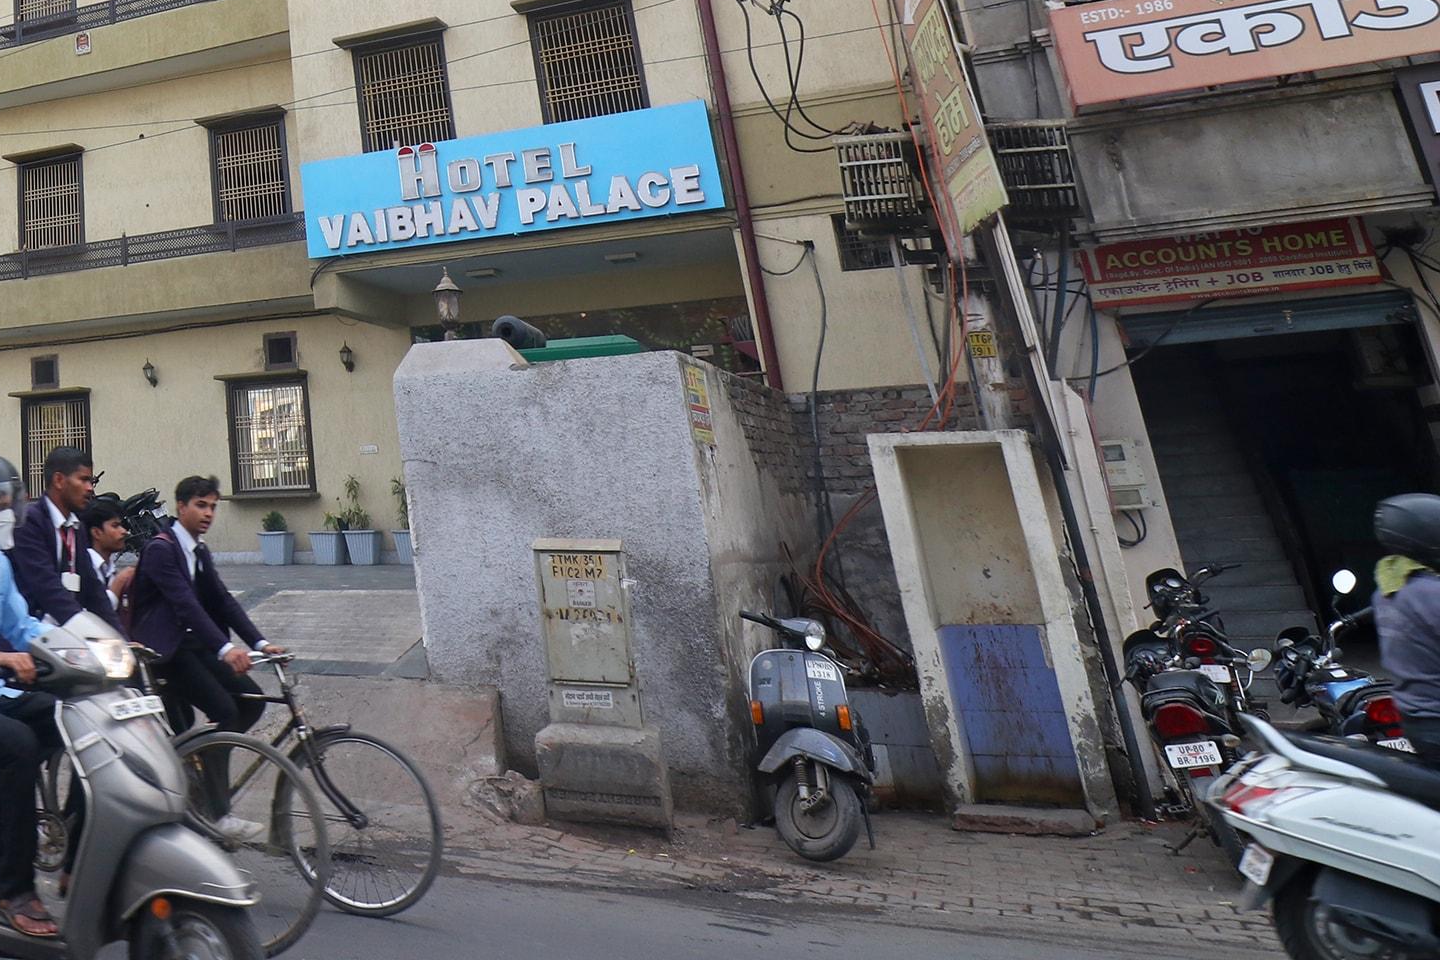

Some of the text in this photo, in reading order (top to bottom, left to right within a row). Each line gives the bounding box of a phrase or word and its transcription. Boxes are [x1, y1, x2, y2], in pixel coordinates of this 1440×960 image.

[933, 83, 971, 156] होम
[396, 142, 592, 201] HOTEL
[318, 164, 706, 250] VAIBHAV PALACE
[1106, 229, 1347, 270] ACCOUNTS HOME
[1226, 272, 1264, 286] JOB
[1310, 264, 1334, 276] JOB
[814, 680, 826, 711] STROKE
